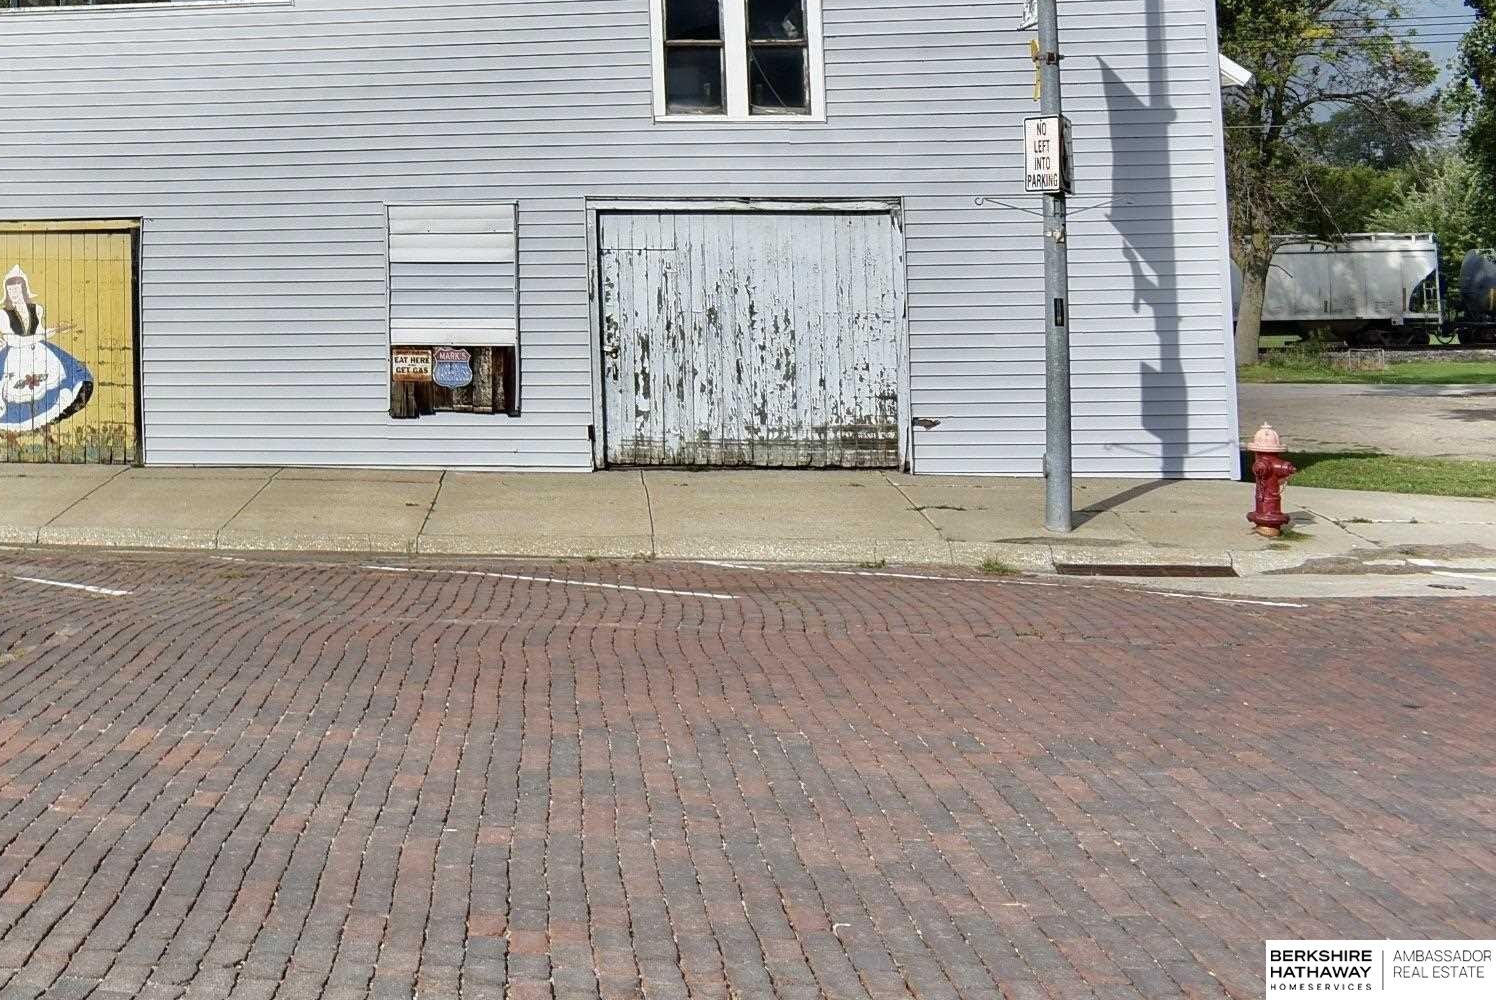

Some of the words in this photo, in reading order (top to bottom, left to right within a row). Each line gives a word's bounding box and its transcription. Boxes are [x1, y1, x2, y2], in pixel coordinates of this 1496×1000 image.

[1037, 122, 1047, 136] NO
[1034, 139, 1050, 153] LEFT
[1034, 156, 1050, 170] INTO
[1027, 173, 1058, 188] PARKING
[394, 356, 408, 364] EAT
[410, 356, 430, 364] HERE
[395, 366, 410, 374] GET
[412, 366, 429, 374] GAS
